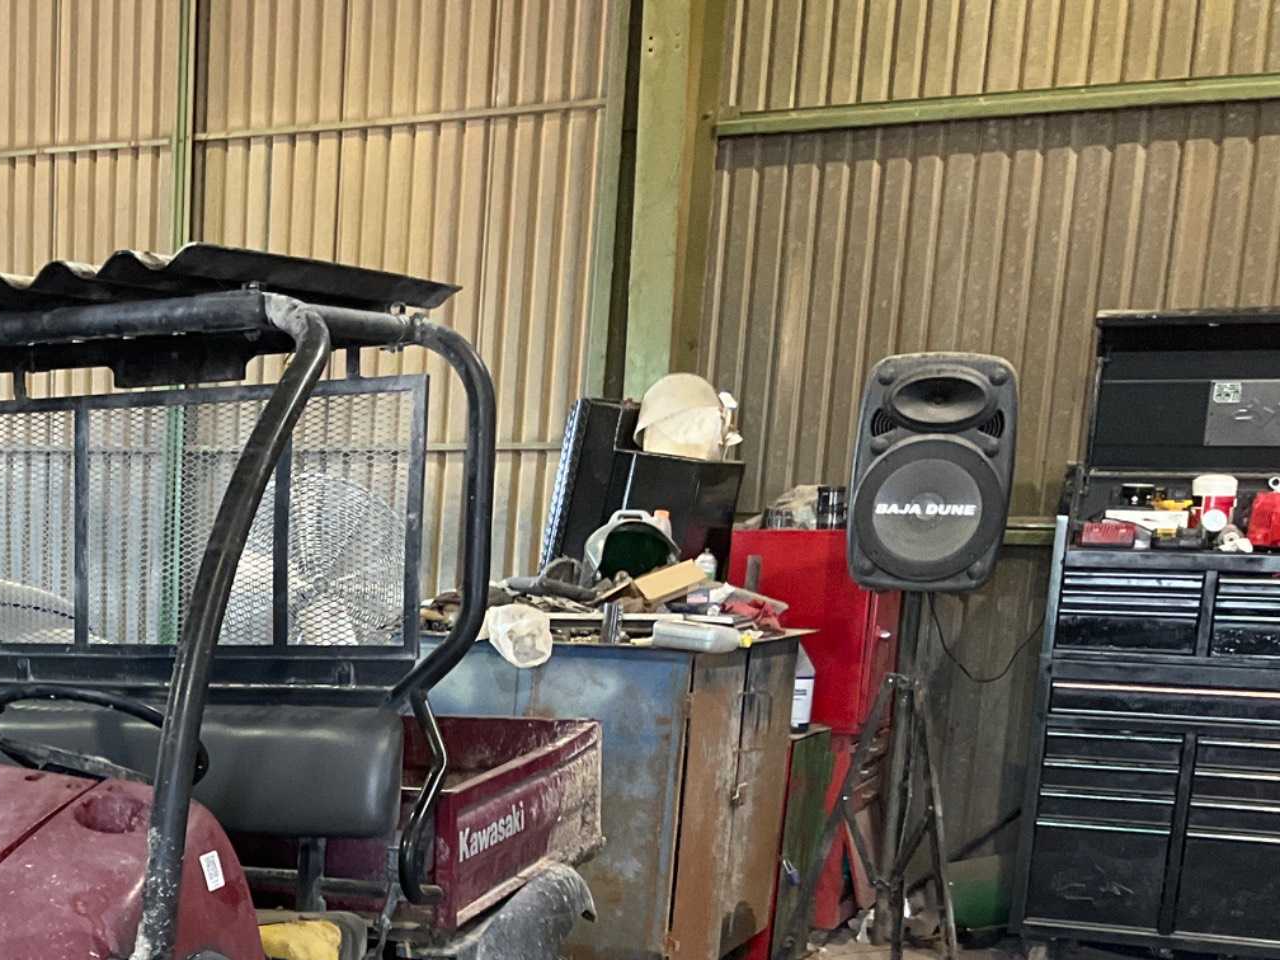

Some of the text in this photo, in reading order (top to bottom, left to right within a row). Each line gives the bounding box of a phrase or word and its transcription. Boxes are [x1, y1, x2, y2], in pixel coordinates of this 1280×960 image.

[875, 503, 977, 515] BAJA DUNE
[459, 801, 525, 862] Kawasaki
